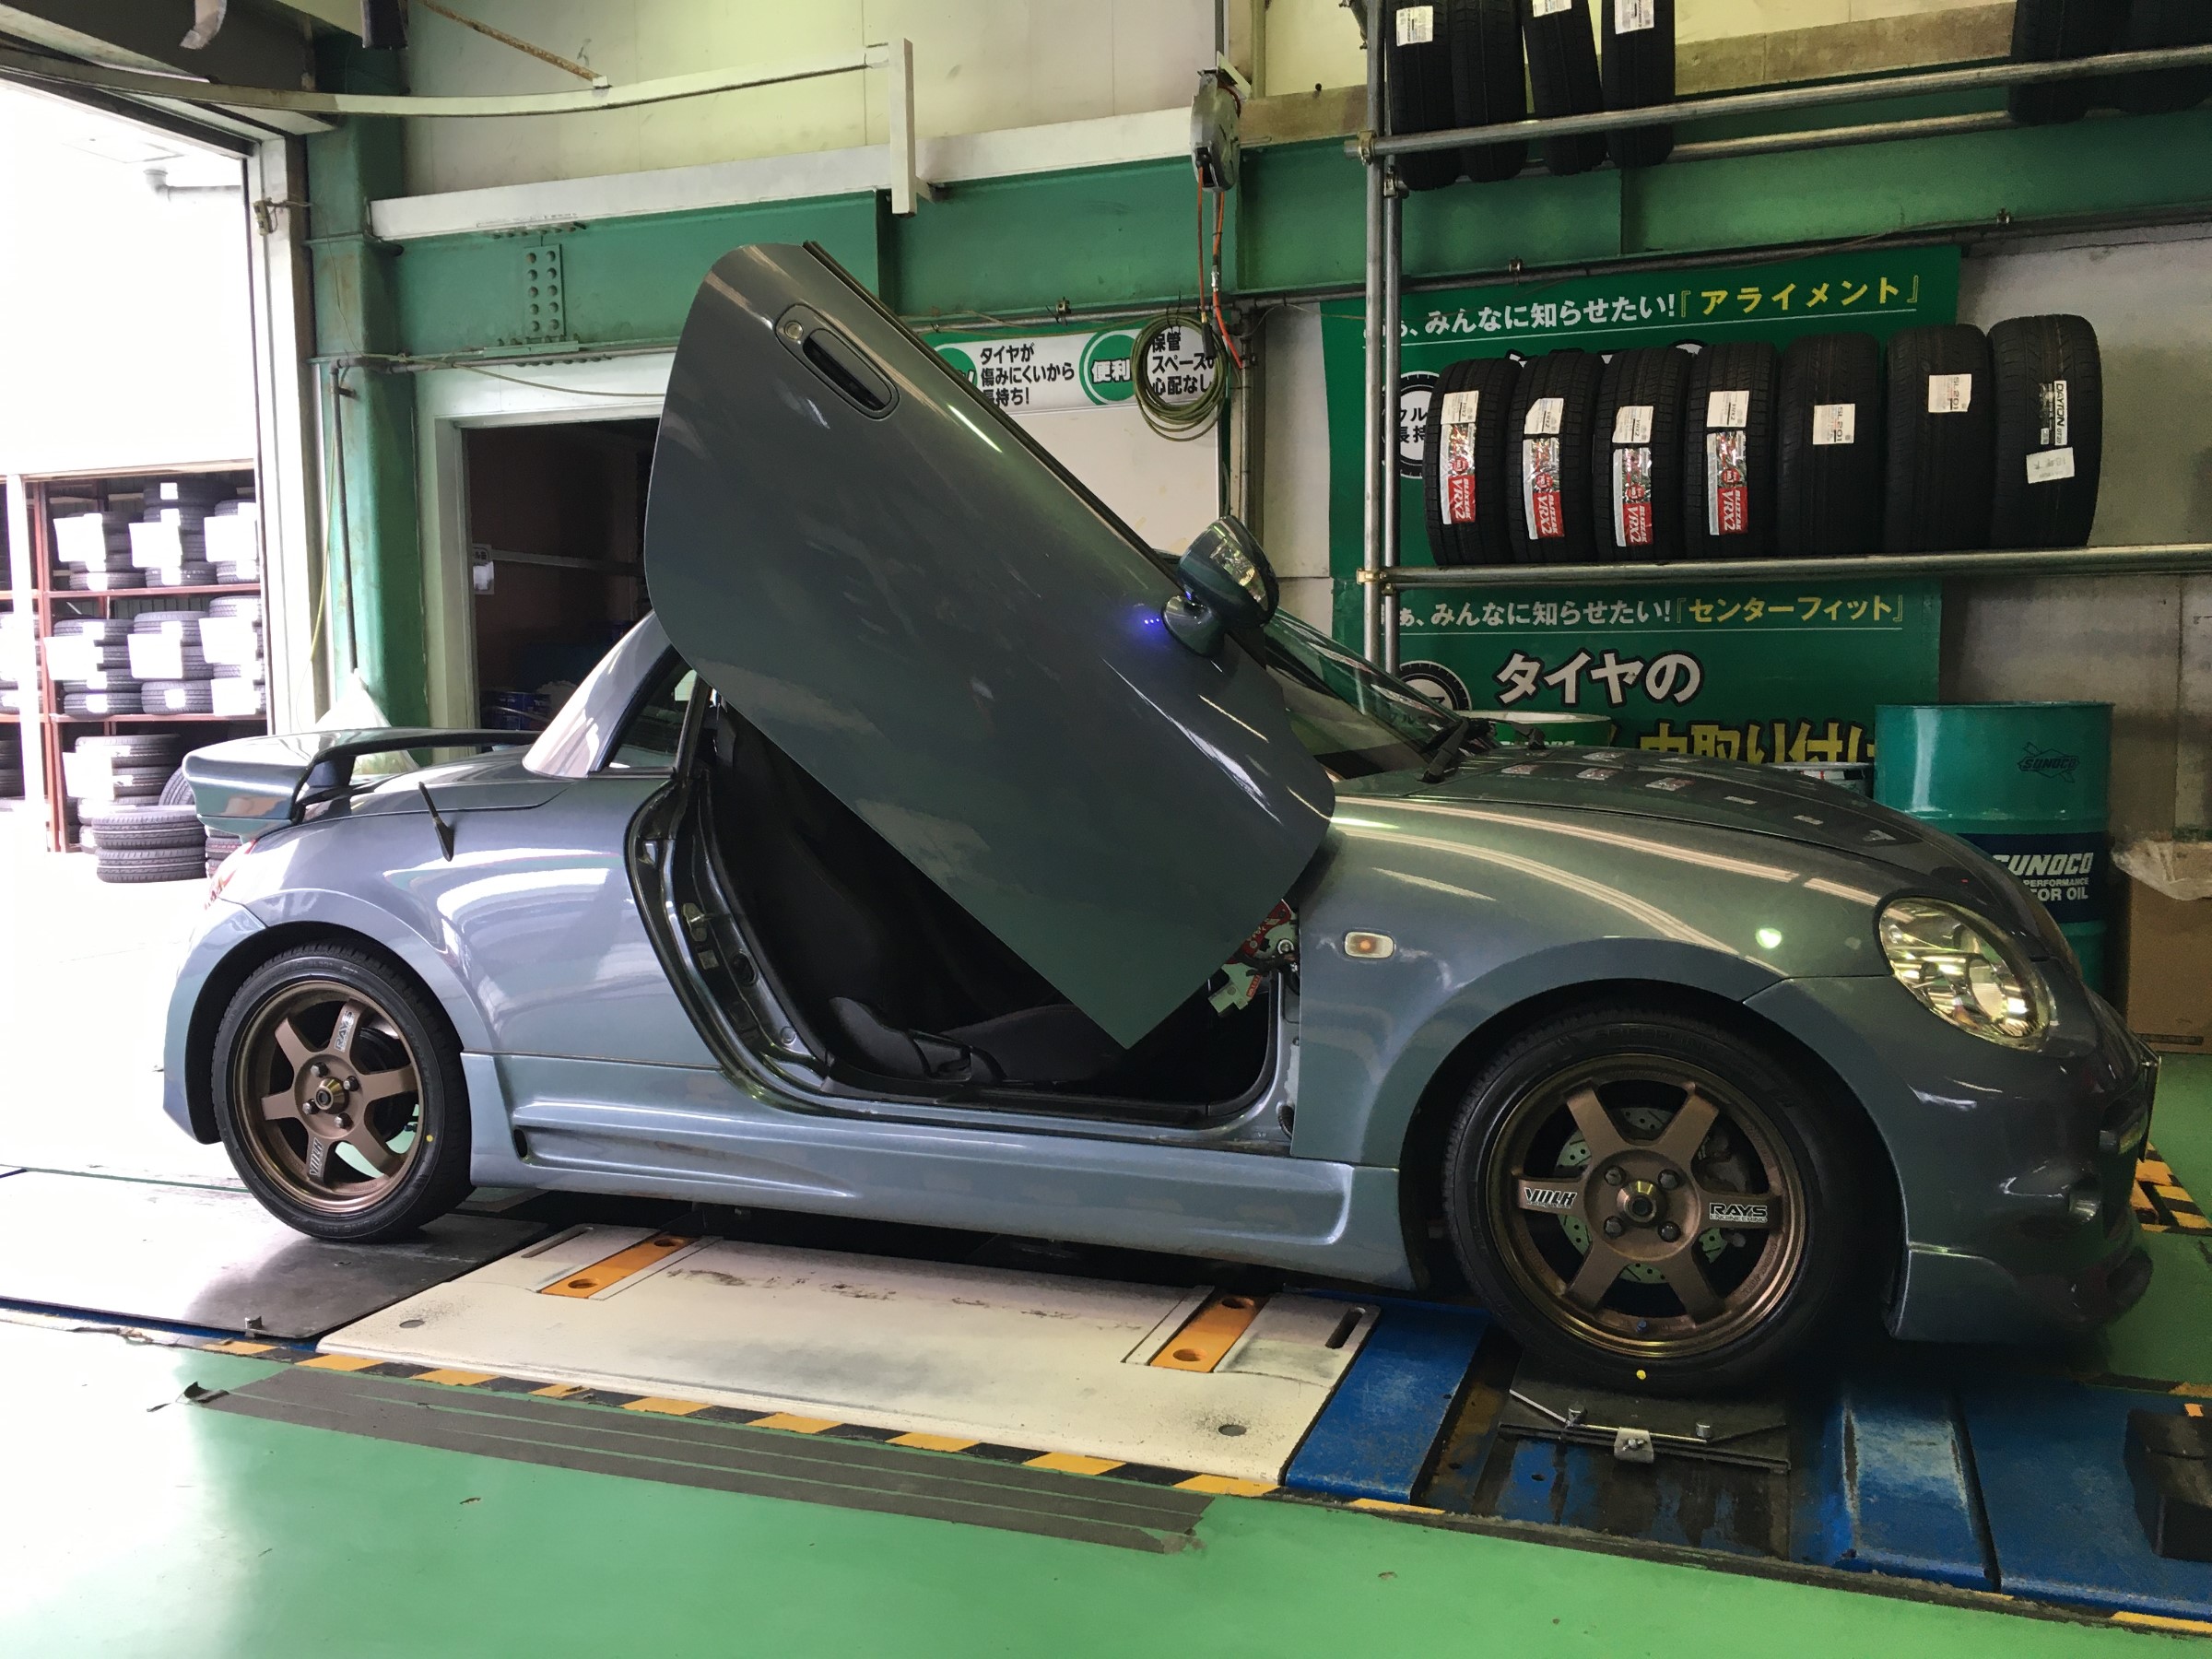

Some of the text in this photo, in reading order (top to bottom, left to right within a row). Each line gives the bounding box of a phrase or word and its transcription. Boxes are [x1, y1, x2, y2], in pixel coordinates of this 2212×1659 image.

[980, 342, 1034, 365] タイヤが
[1090, 358, 1131, 382] 便利
[981, 362, 1075, 387] 傷みにくいから
[2056, 382, 2065, 427] DAYTON
[1453, 478, 1467, 519] VRX2
[1537, 495, 1553, 535] VRX2
[1548, 494, 1559, 534] BLIZZAK
[1722, 490, 1735, 531] VRX2
[1734, 489, 1742, 531] BLIZZAK
[1628, 506, 1641, 544] VRX2
[1639, 505, 1648, 543] BLIZZAK
[1494, 649, 1703, 706] タイヤの
[2023, 758, 2077, 771] SUNOCO
[2066, 887, 2088, 900] OIL
[1710, 1203, 1768, 1217] RAYS
